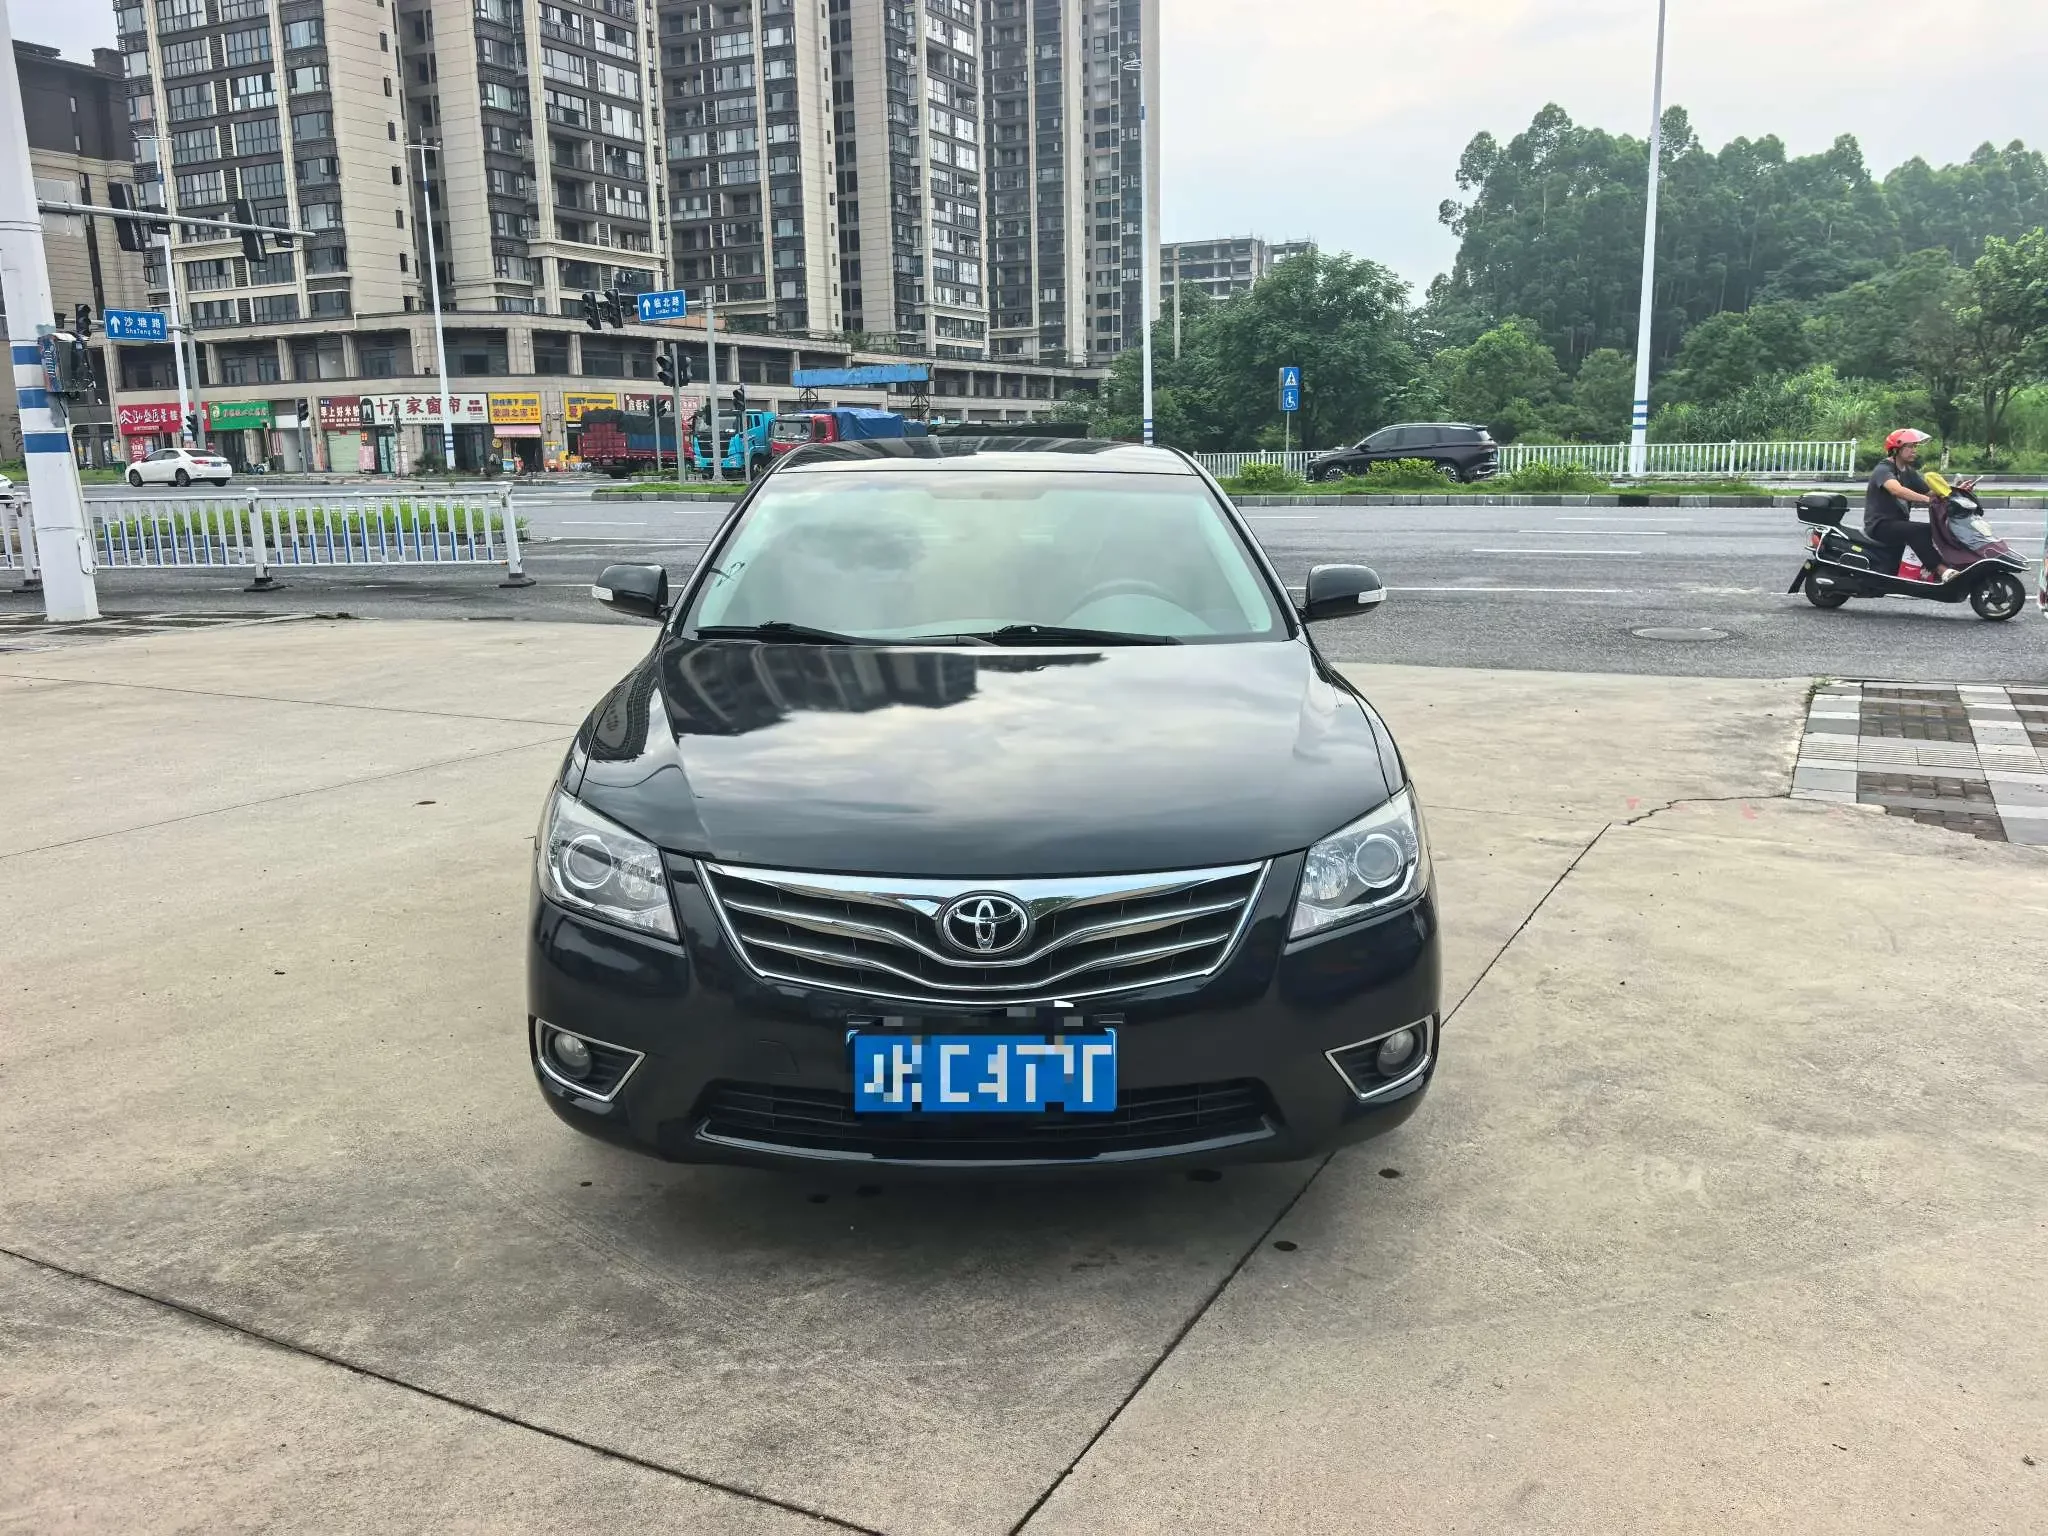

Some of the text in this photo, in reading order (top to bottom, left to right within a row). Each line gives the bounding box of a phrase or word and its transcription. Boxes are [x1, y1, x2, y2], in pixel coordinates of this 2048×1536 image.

[653, 296, 679, 308] 临北路
[123, 315, 161, 328] 沙塘路
[320, 405, 360, 418] 早上好米粉
[375, 395, 461, 416] 十万家窗帘
